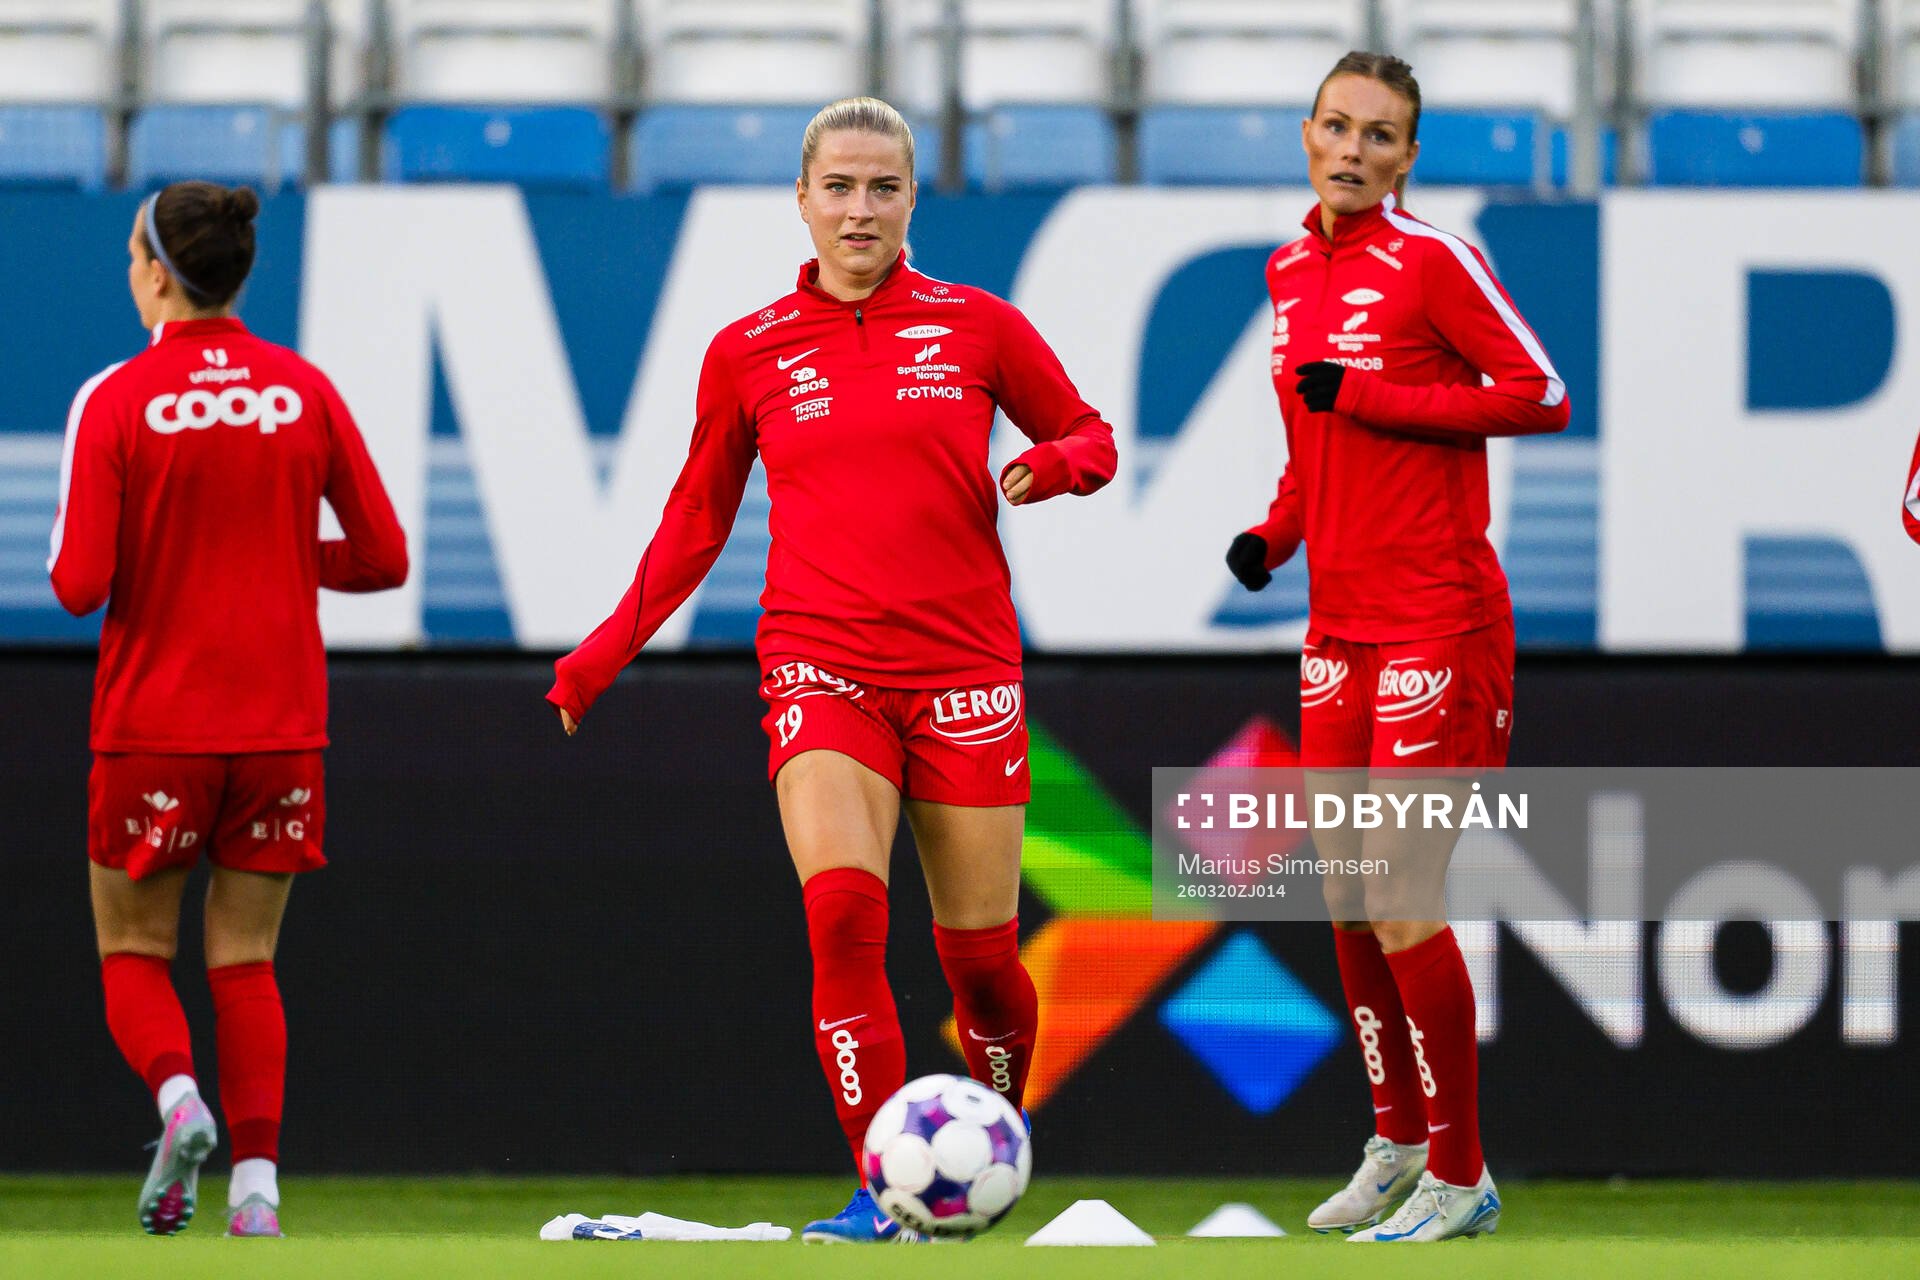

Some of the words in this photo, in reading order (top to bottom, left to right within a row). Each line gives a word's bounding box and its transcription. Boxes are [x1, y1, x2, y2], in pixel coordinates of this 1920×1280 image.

[911, 290, 966, 304] Tidsbanken
[744, 309, 801, 339] Tidsbanken
[896, 363, 961, 376] Sparebanken
[916, 371, 946, 381] Norge
[788, 378, 830, 397] OBOS
[896, 386, 963, 401] FOTMOB
[144, 384, 303, 435] coop
[790, 397, 834, 416] THON
[796, 408, 831, 423] HOTELS
[1377, 669, 1443, 698] LERØY
[933, 683, 1020, 724] LERØY
[775, 704, 803, 748] 19
[1354, 1006, 1386, 1085] coop
[832, 1029, 863, 1106] coop
[985, 1046, 1012, 1092] coop
